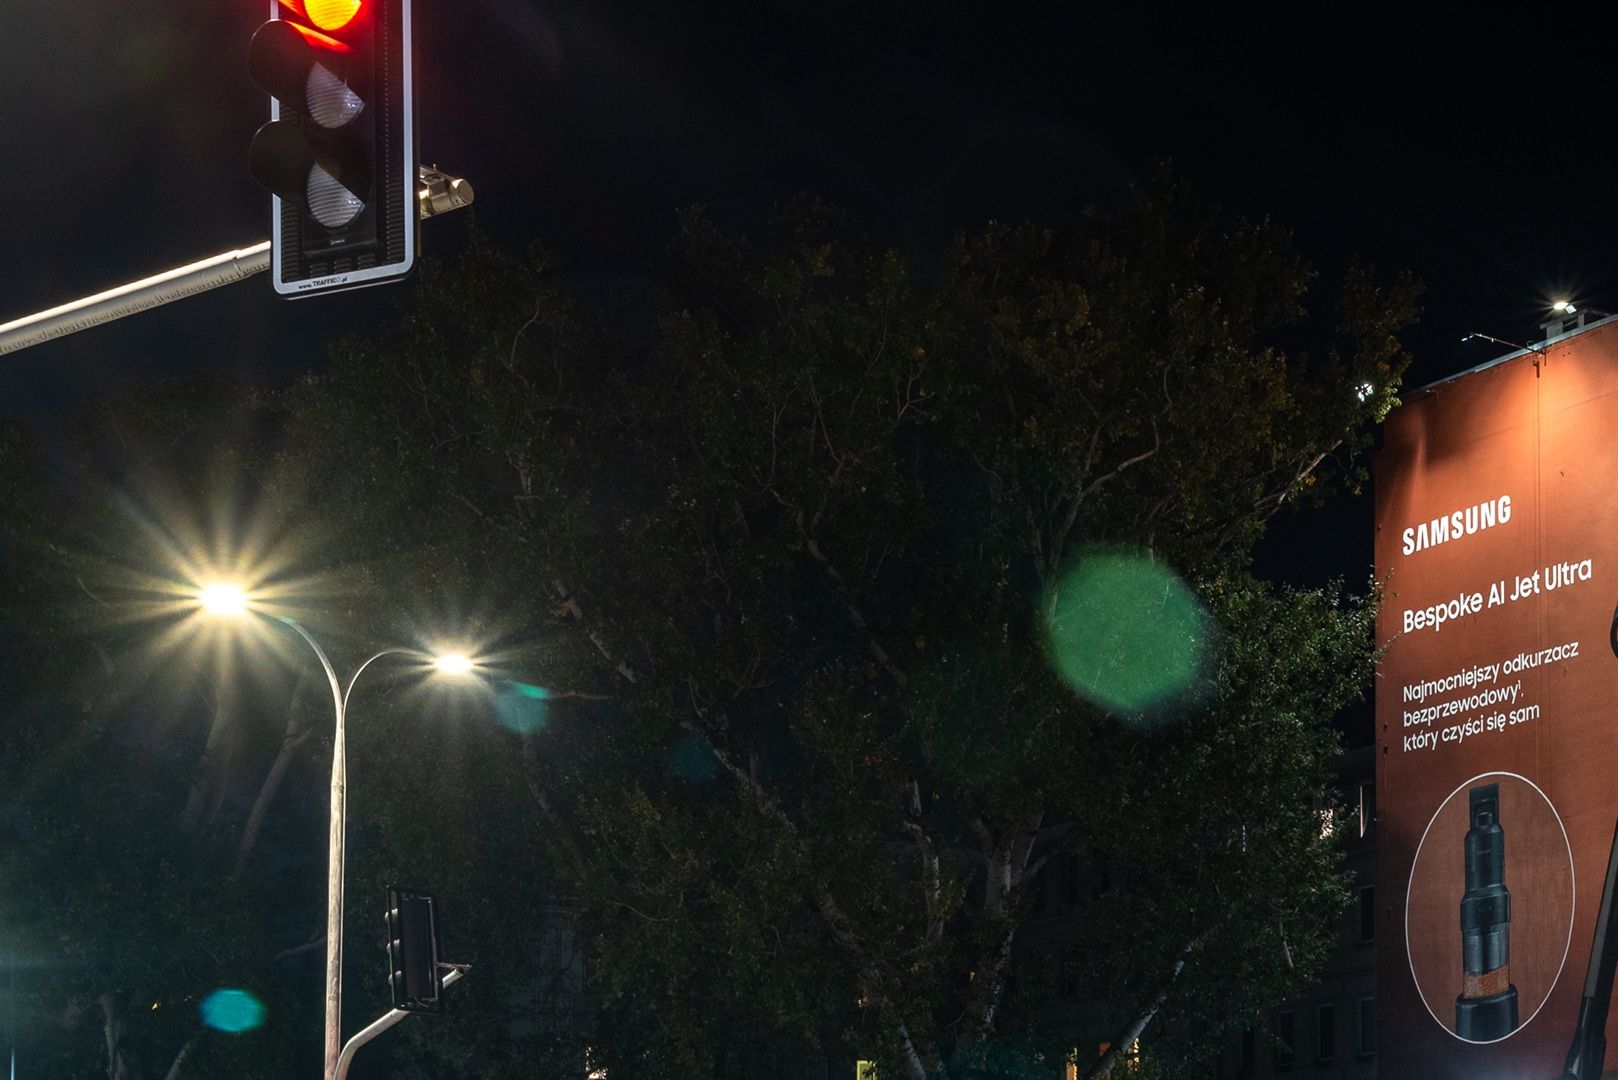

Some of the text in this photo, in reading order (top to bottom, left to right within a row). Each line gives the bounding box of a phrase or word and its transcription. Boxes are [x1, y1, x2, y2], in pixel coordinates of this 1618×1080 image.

[1402, 495, 1511, 556] SAMSUNG
[1403, 558, 1592, 634] Bespoke AI Jet Ultra
[1403, 641, 1579, 703] Najmocniejszy odkurzacz
[1403, 704, 1540, 752] który czyści się sam
